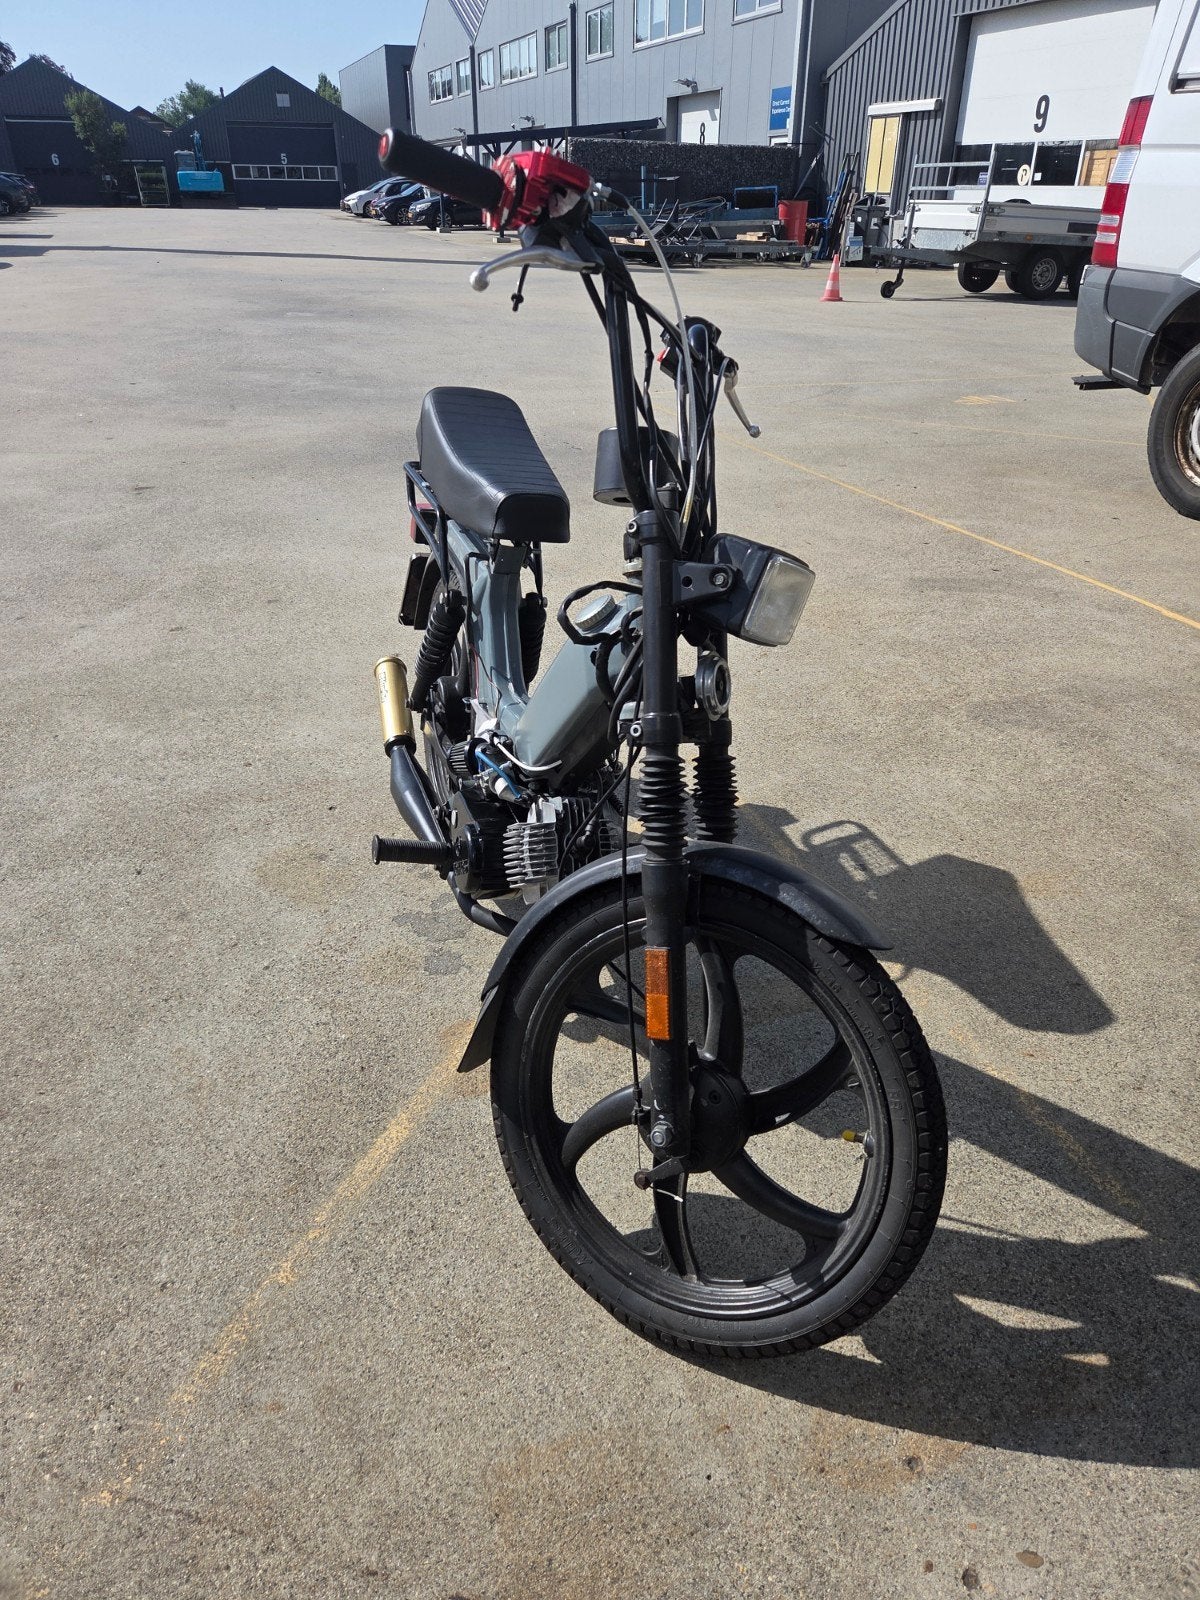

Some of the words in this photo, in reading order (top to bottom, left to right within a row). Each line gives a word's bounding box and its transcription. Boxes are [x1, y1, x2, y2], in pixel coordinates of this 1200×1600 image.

[1033, 94, 1050, 133] 9
[700, 122, 706, 144] 8
[51, 153, 60, 165] 6
[281, 153, 288, 164] 5
